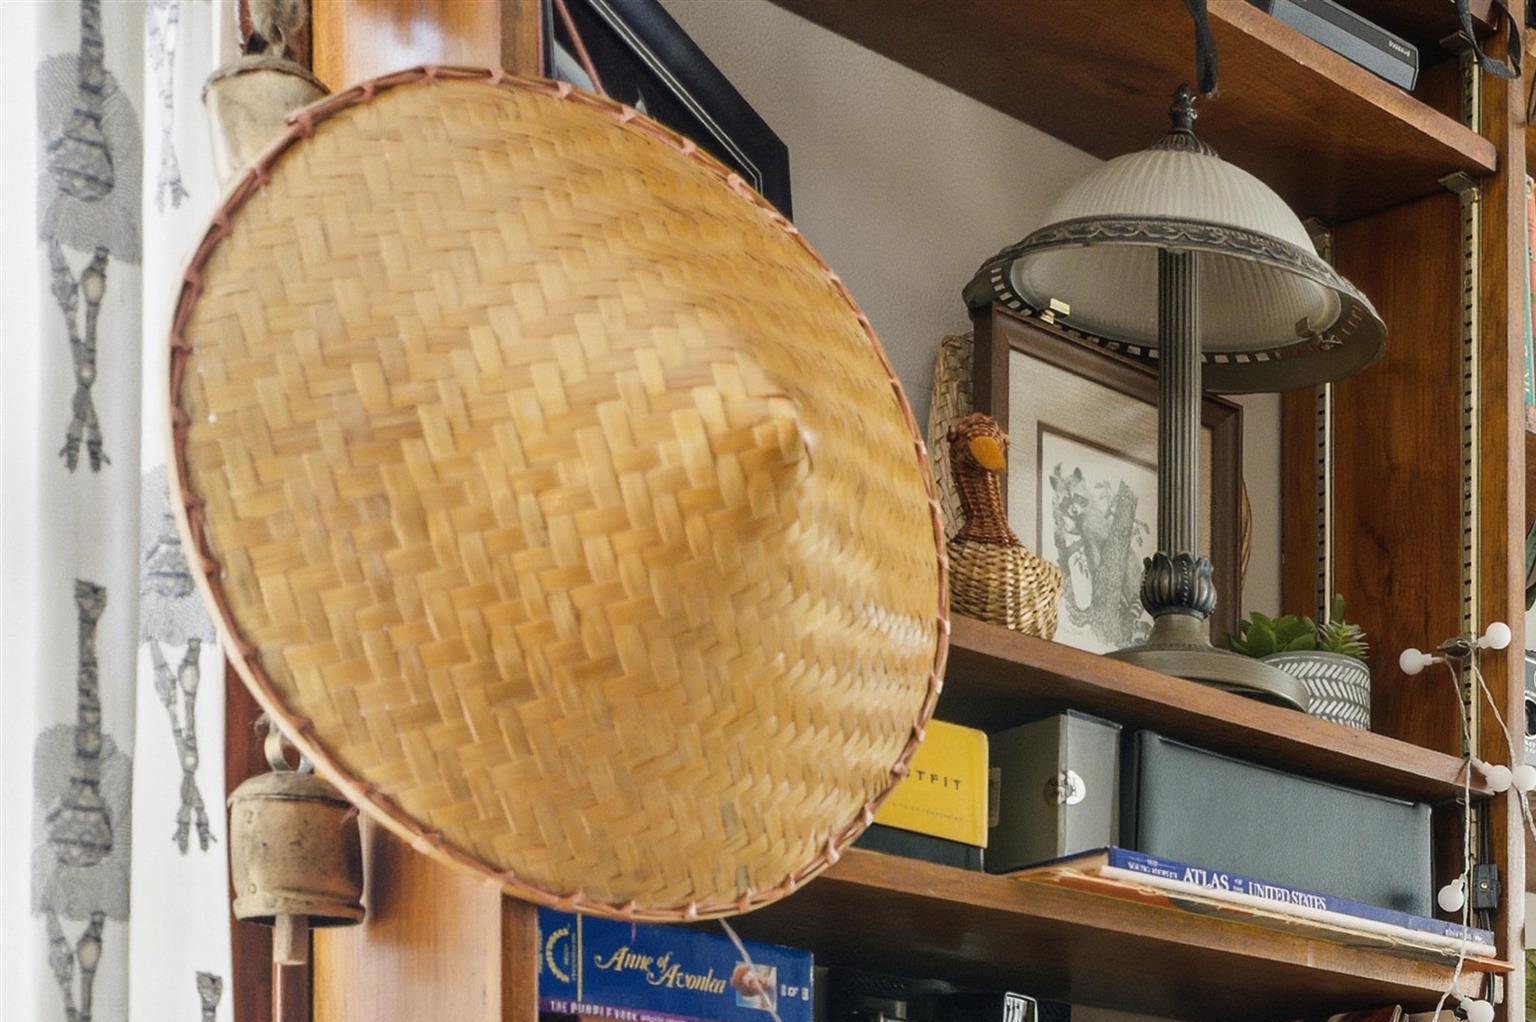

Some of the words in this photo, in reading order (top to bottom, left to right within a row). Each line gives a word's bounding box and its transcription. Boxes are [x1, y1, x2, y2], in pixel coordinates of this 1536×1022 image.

[905, 769, 962, 791] TFIT
[1183, 867, 1229, 891] ATLAS
[1249, 881, 1288, 904] UNITED
[1288, 887, 1327, 910] STATES
[594, 945, 653, 971] Anne
[657, 951, 673, 971] of
[646, 963, 727, 996] Avonlea
[551, 1001, 567, 1014] THE
